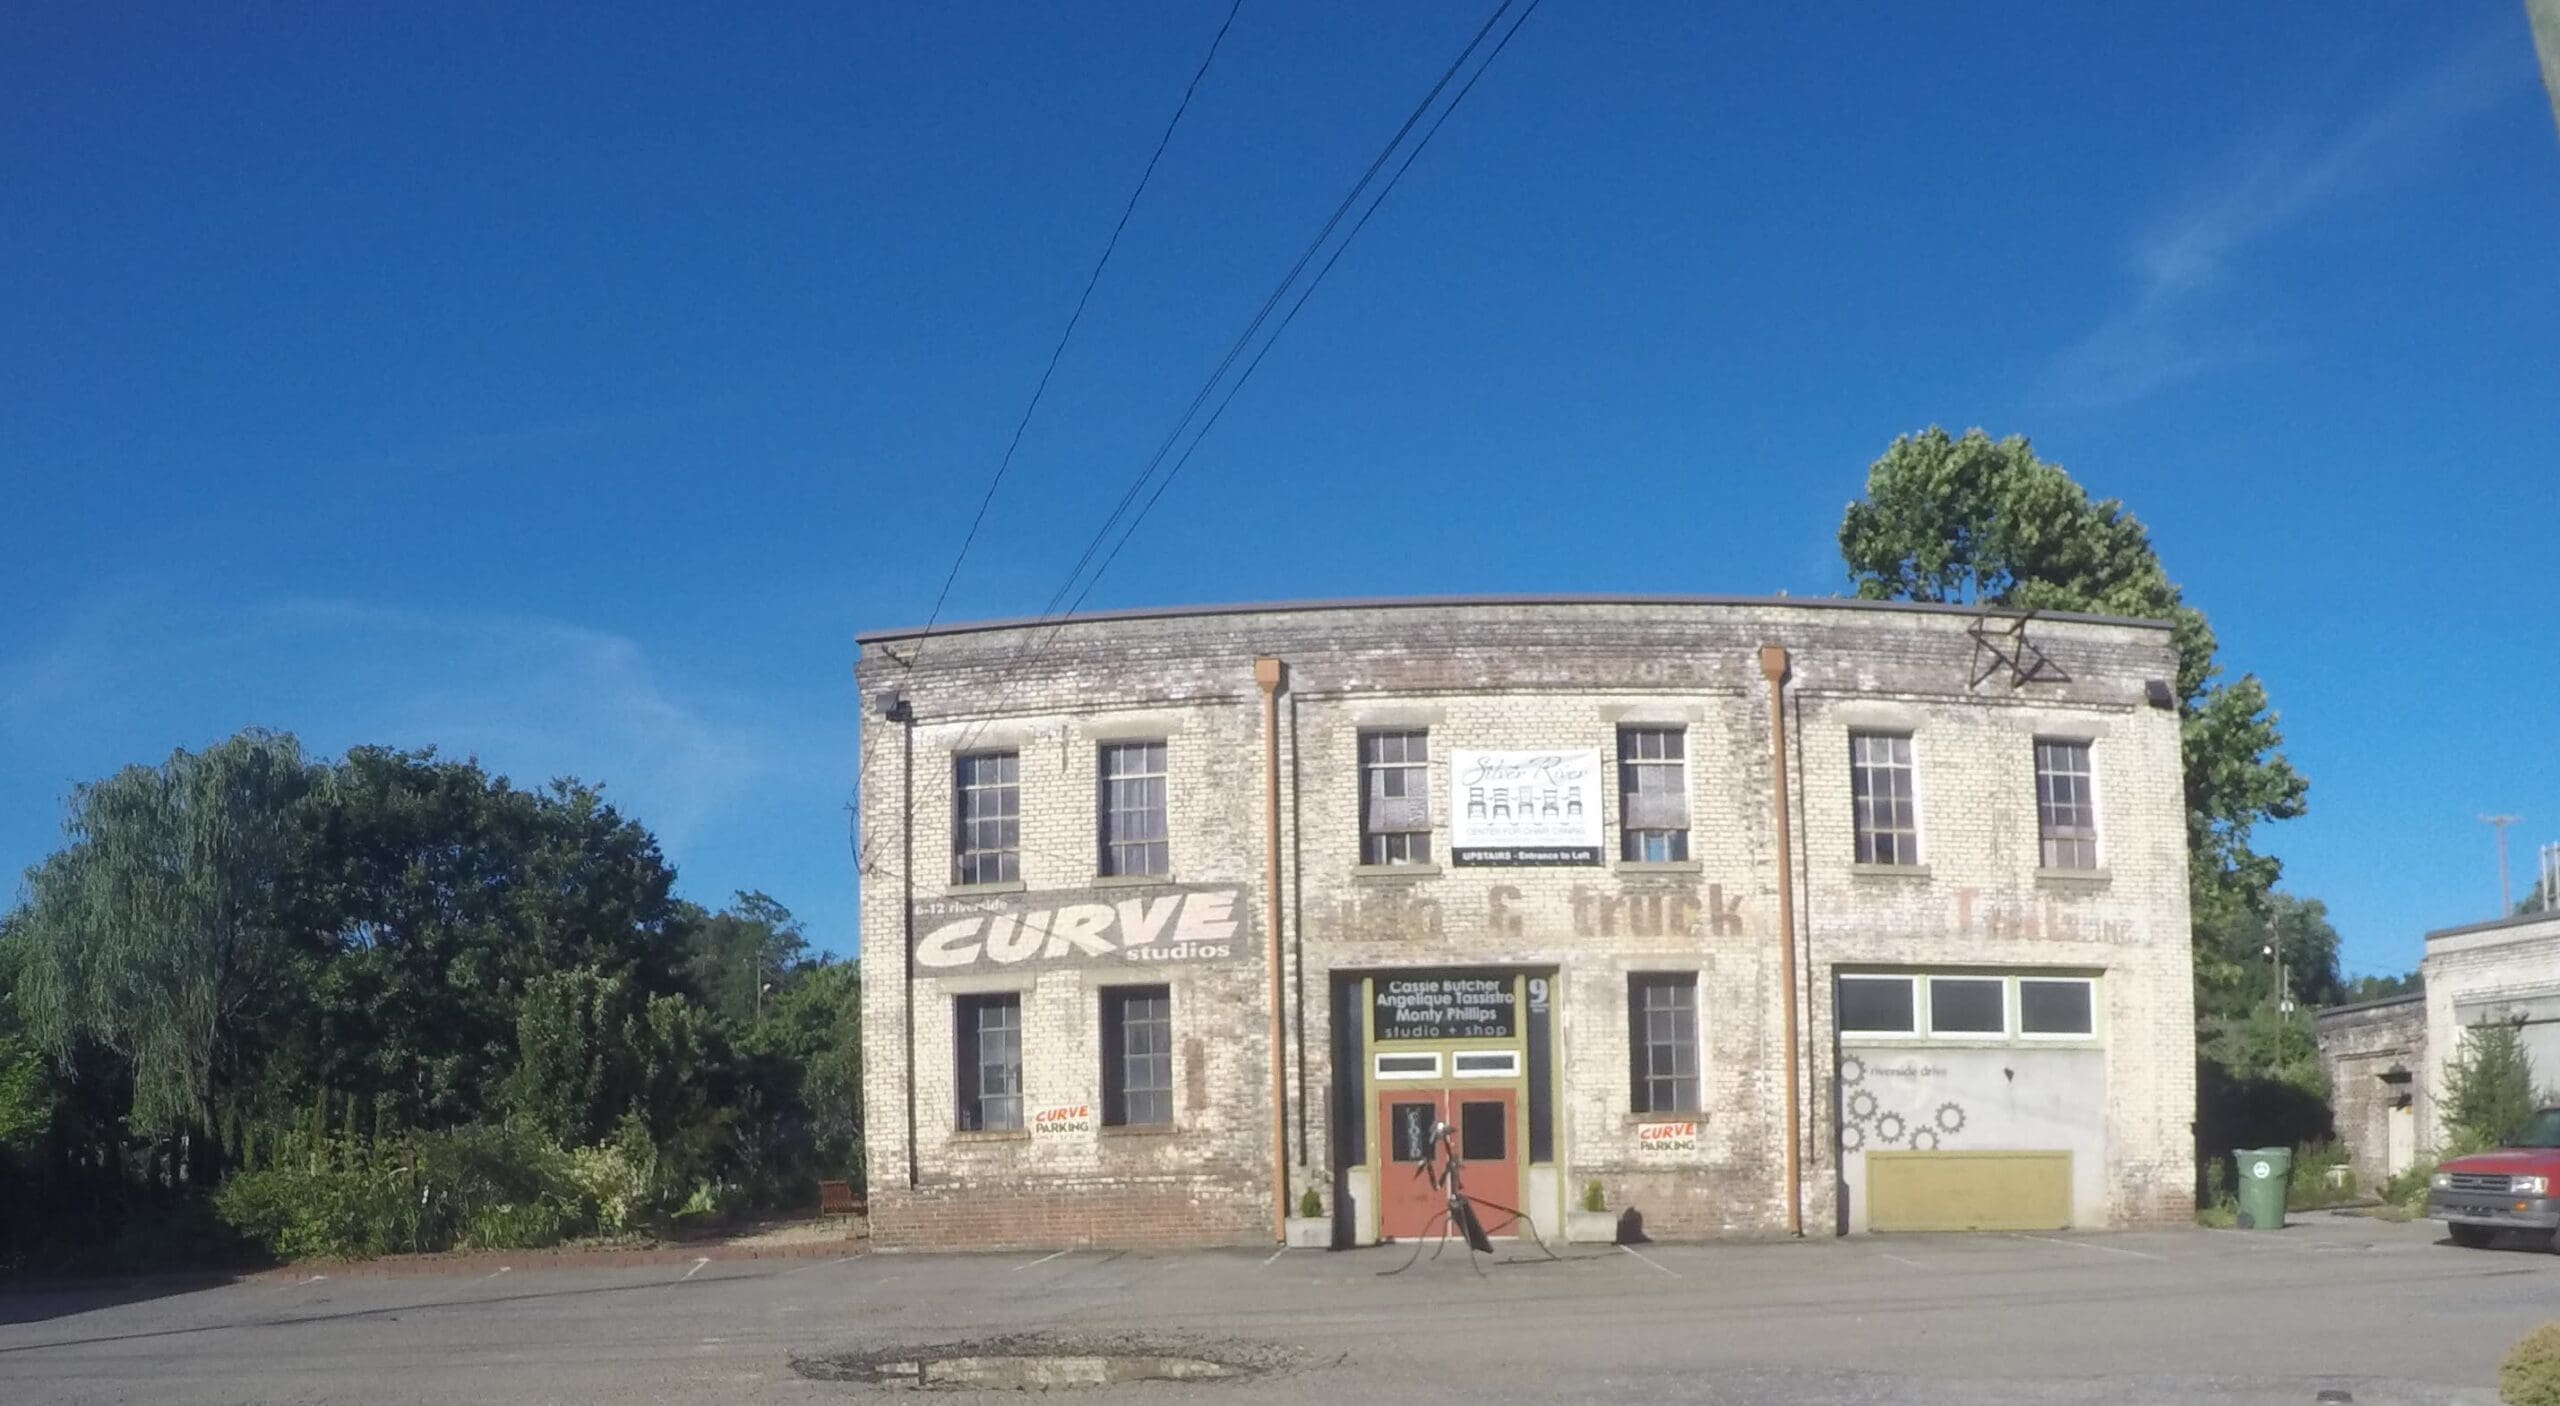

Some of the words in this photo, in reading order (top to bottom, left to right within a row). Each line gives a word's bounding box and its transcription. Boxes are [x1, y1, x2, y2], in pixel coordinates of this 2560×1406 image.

[1462, 852, 1511, 861] UPSTAIRS
[1518, 852, 1559, 860] Entrance
[1560, 852, 1570, 860] to
[1572, 851, 1590, 860] Left
[948, 899, 1008, 912] riverside
[1568, 883, 1745, 938] truck
[916, 891, 1239, 967] CURVE
[1126, 943, 1231, 961] studios
[1389, 981, 1439, 994] Cassie
[1443, 980, 1500, 992] Butcher
[1528, 978, 1548, 1003] 9
[1377, 993, 1452, 1008] Angelique
[1456, 991, 1515, 1004] Tassistro
[1396, 1008, 1443, 1023] Monty
[1447, 1007, 1497, 1021] Phillips
[1385, 1026, 1440, 1038] studio
[1465, 1024, 1507, 1036] shop
[1036, 1104, 1088, 1121] CURVE
[1036, 1121, 1089, 1133] PARKING
[1640, 1121, 1694, 1139] CURVE
[1640, 1140, 1695, 1151] PARKING
